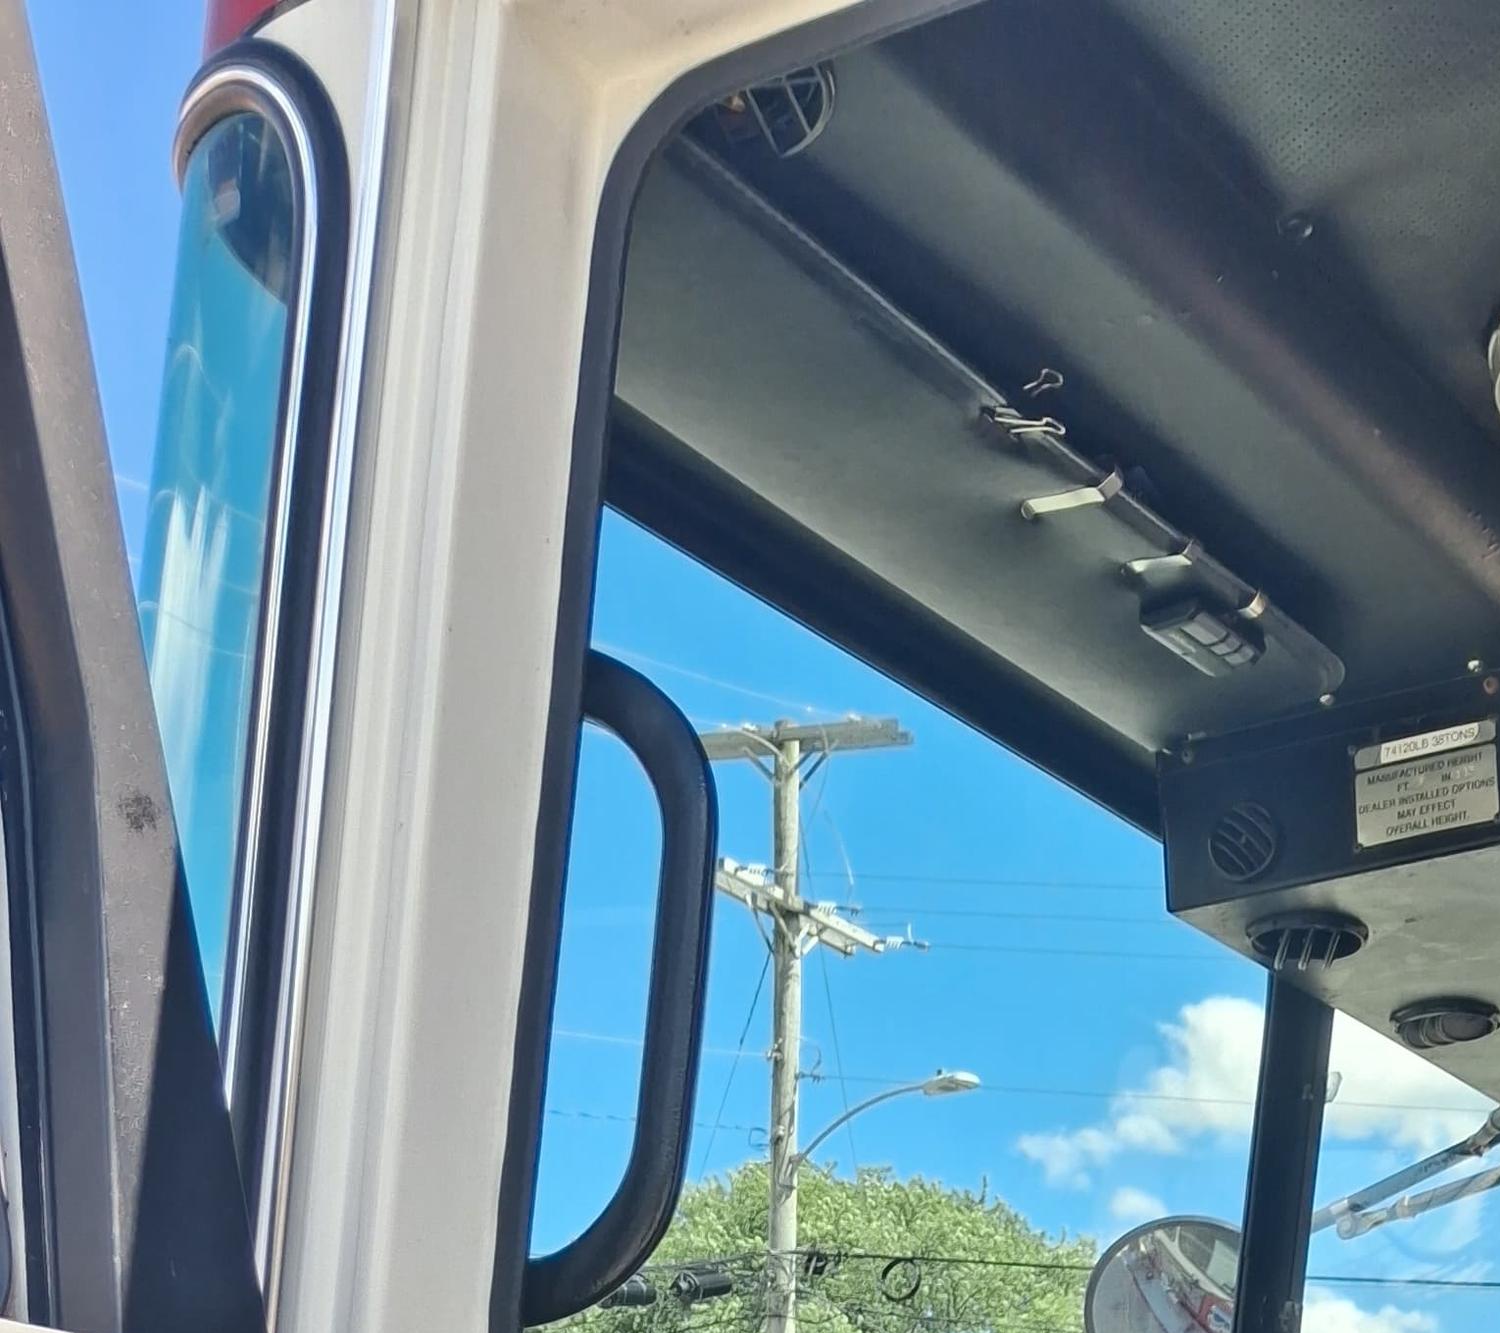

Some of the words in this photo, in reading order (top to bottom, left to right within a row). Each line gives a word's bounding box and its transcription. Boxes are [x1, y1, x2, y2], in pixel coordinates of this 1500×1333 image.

[1367, 761, 1445, 785] MANUFACTURED
[1447, 752, 1483, 767] HEIGHT
[1358, 799, 1396, 815] DEALER
[1398, 786, 1449, 807] INSTALLED
[1451, 776, 1495, 795] OPTIONS
[1397, 808, 1417, 820] MAY
[1419, 799, 1456, 815] EFFECT
[1386, 819, 1428, 836] OVERALL
